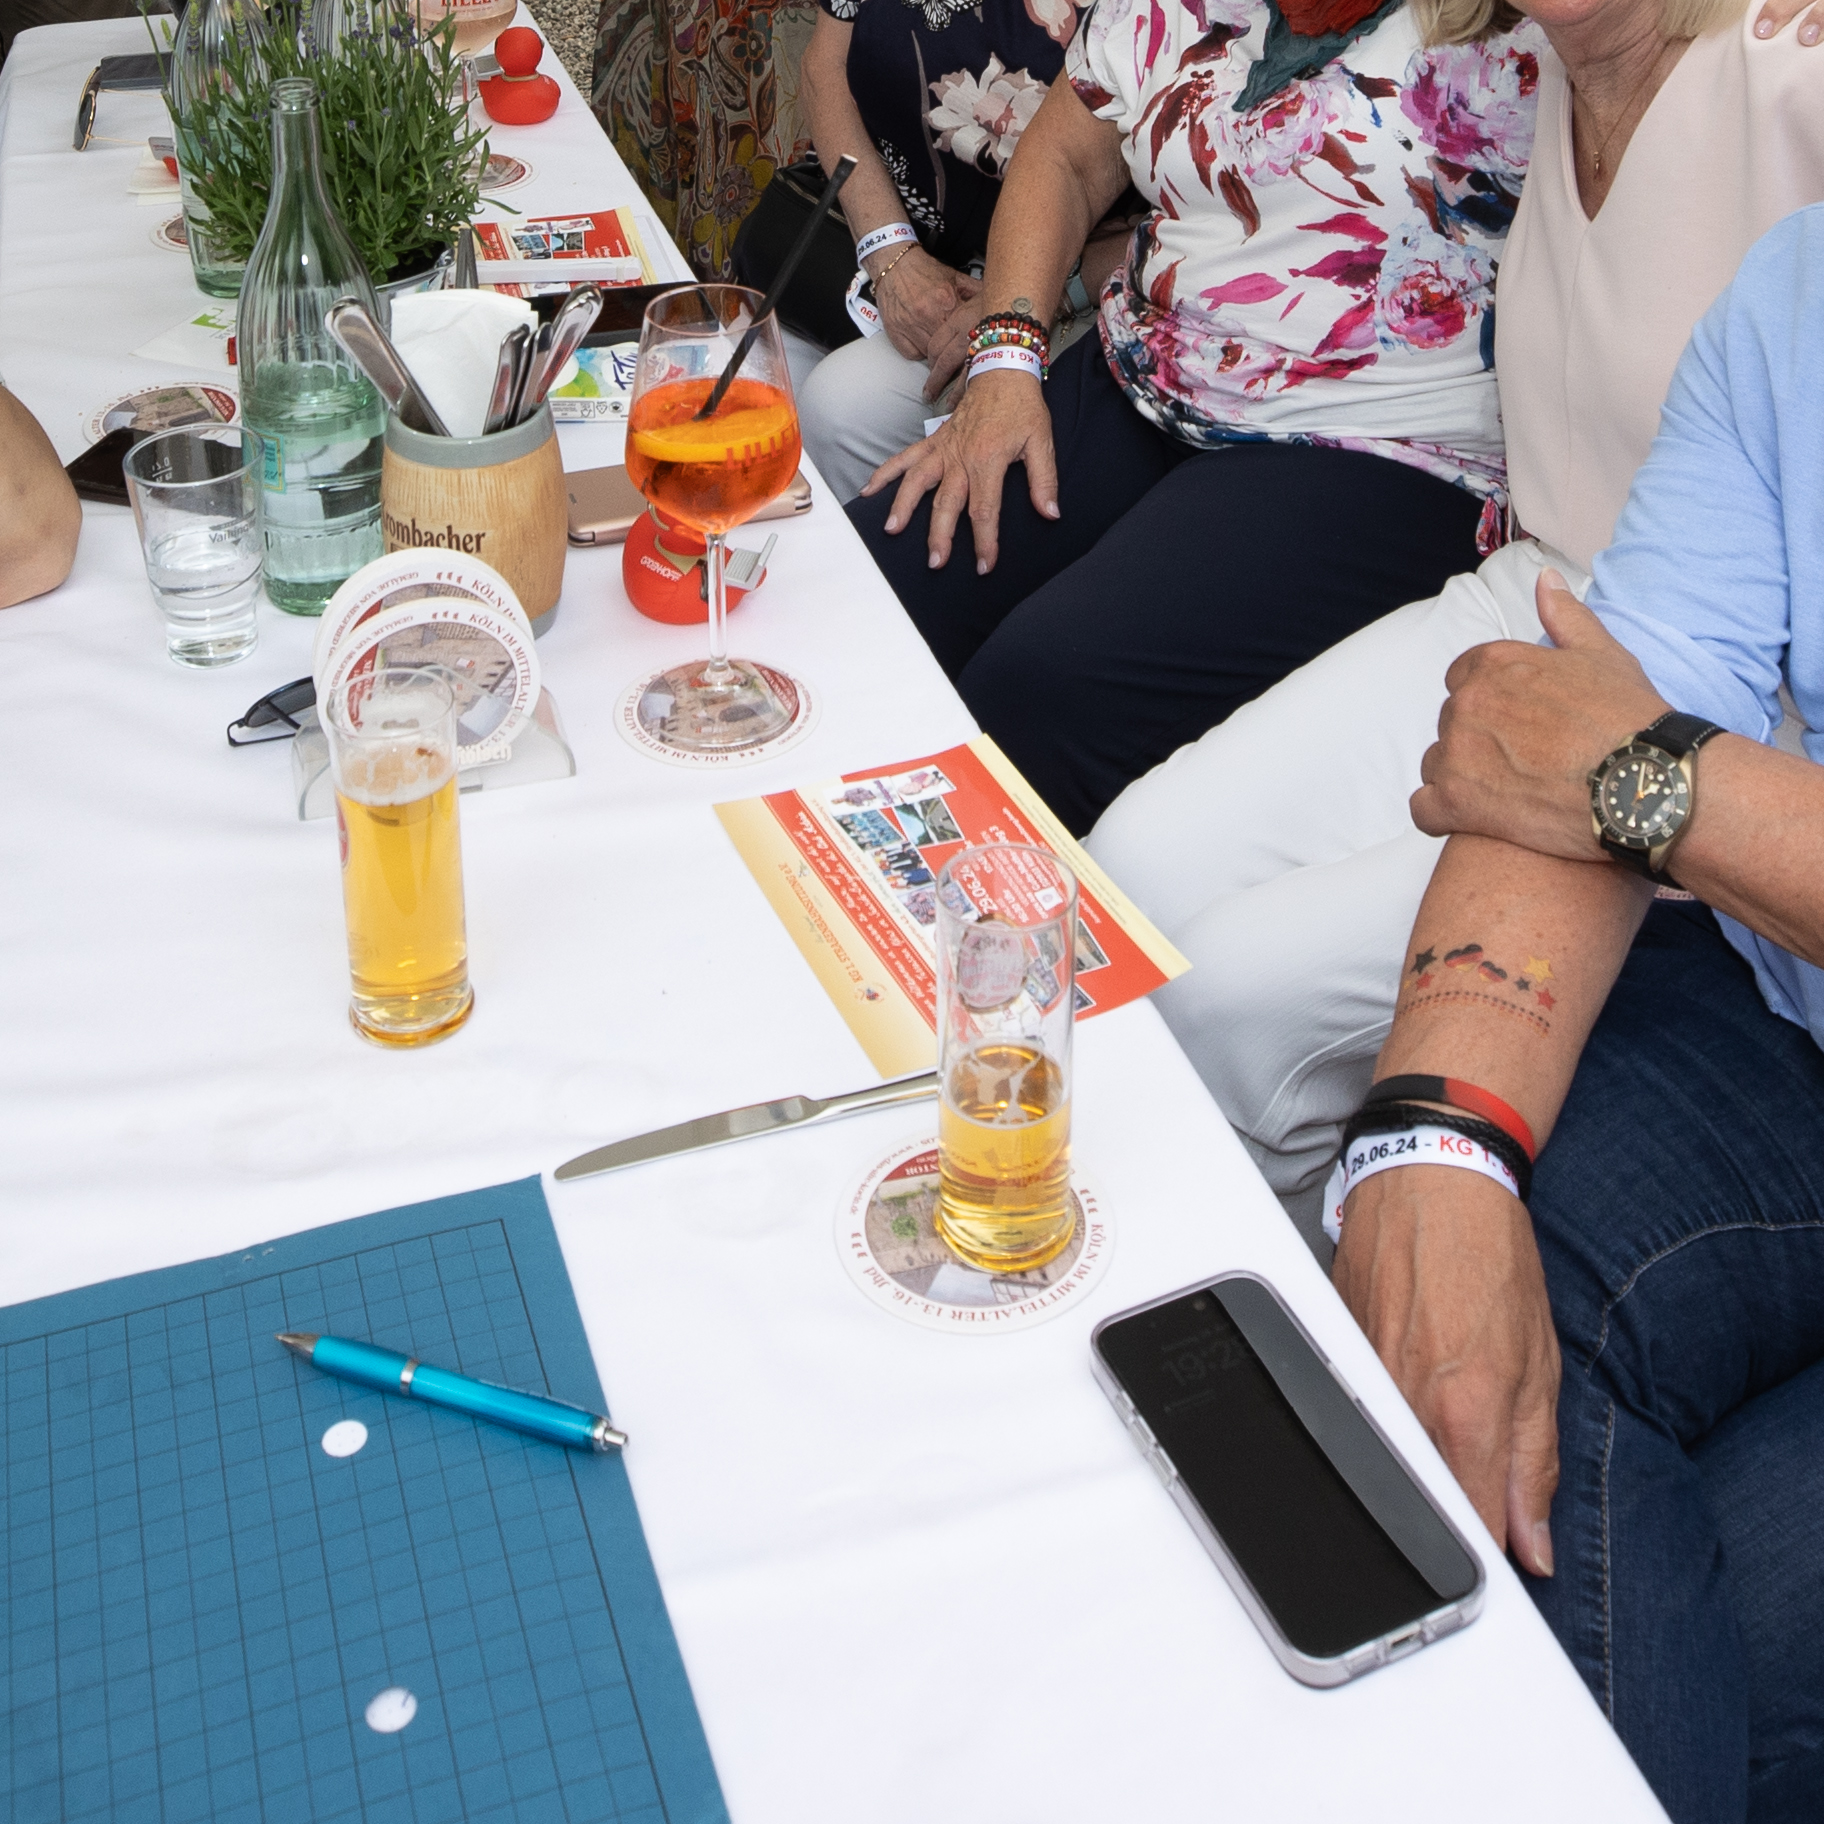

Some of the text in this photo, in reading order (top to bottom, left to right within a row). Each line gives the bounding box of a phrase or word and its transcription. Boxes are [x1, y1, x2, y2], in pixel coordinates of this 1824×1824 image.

[382, 515, 486, 554] rombacher
[469, 613, 506, 634] KÖLN
[960, 864, 998, 914] 29.06.24
[1351, 1135, 1418, 1174] 29.06.24
[1439, 1135, 1473, 1156] KG
[1084, 1221, 1107, 1261] KÖLN
[1072, 1261, 1089, 1279] IM
[949, 1278, 1076, 1322] MITTELALTER
